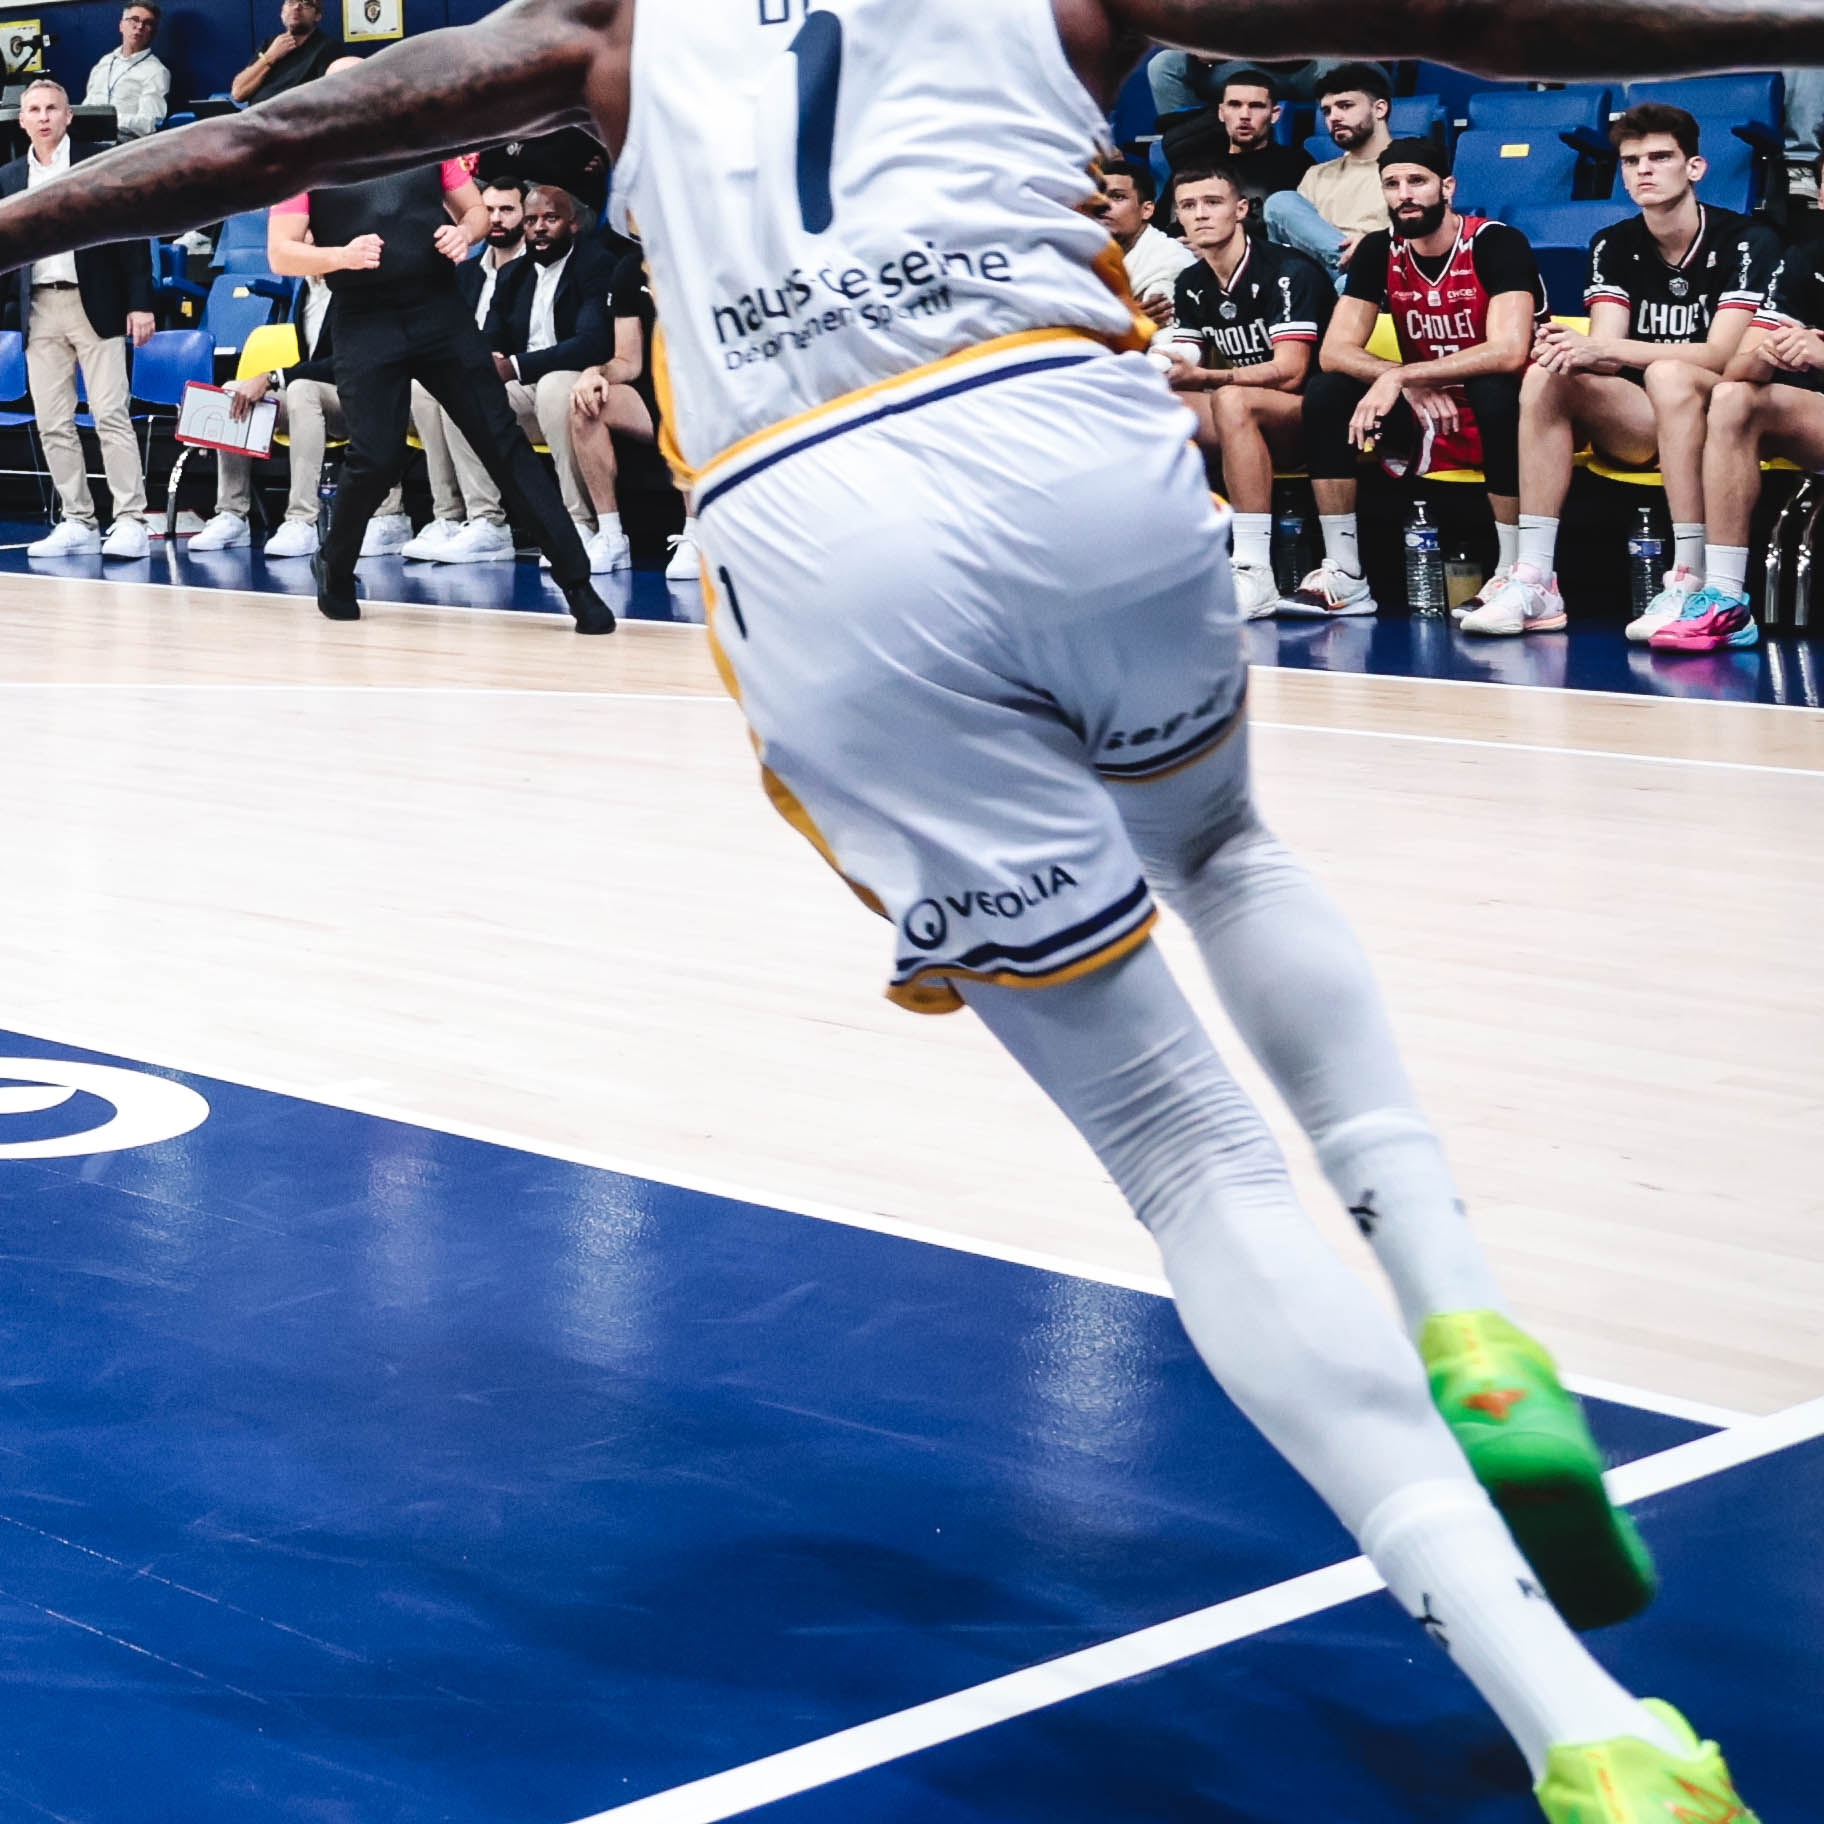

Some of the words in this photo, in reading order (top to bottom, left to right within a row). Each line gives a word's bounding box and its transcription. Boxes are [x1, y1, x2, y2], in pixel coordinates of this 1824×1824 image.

[788, 10, 843, 236] 1
[1201, 317, 1273, 356] CHOLET
[1407, 308, 1476, 340] CHOLET
[718, 565, 748, 640] 1
[943, 865, 1079, 923] VEOLIA
